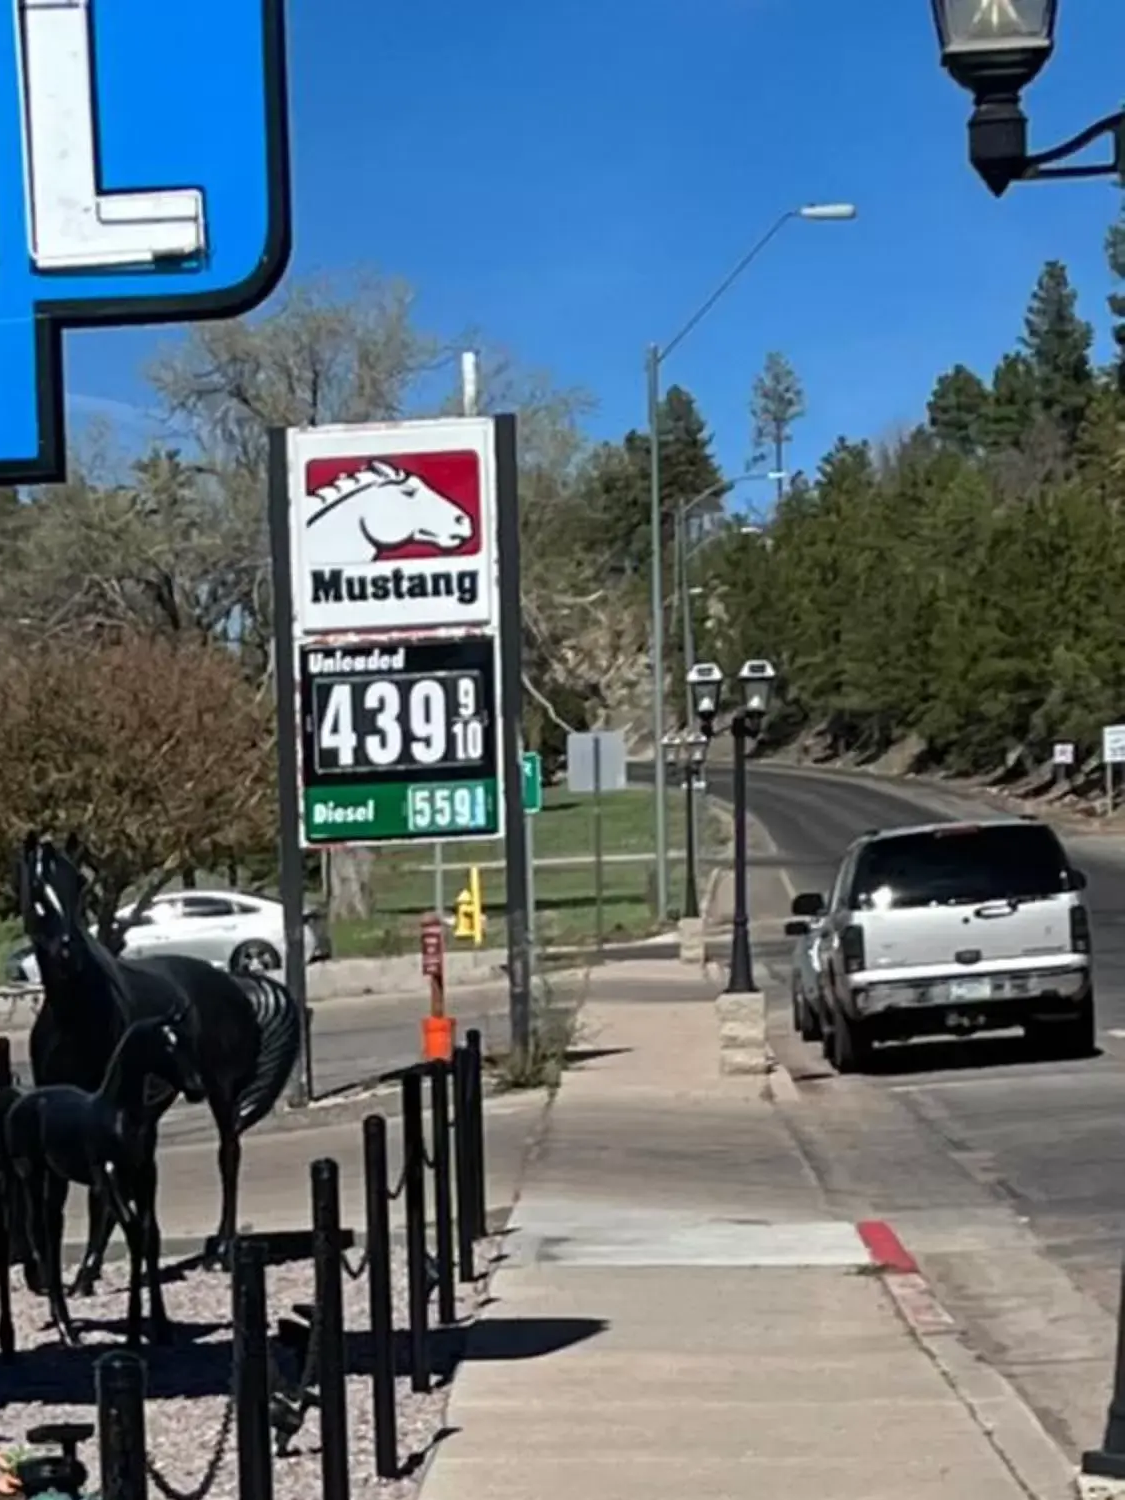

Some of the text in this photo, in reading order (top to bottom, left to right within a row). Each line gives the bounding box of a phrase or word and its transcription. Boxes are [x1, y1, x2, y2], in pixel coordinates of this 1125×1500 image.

[311, 567, 479, 605] Mustang
[308, 647, 406, 673] Unleaded
[320, 679, 448, 767] 439
[313, 799, 375, 825] Diesel
